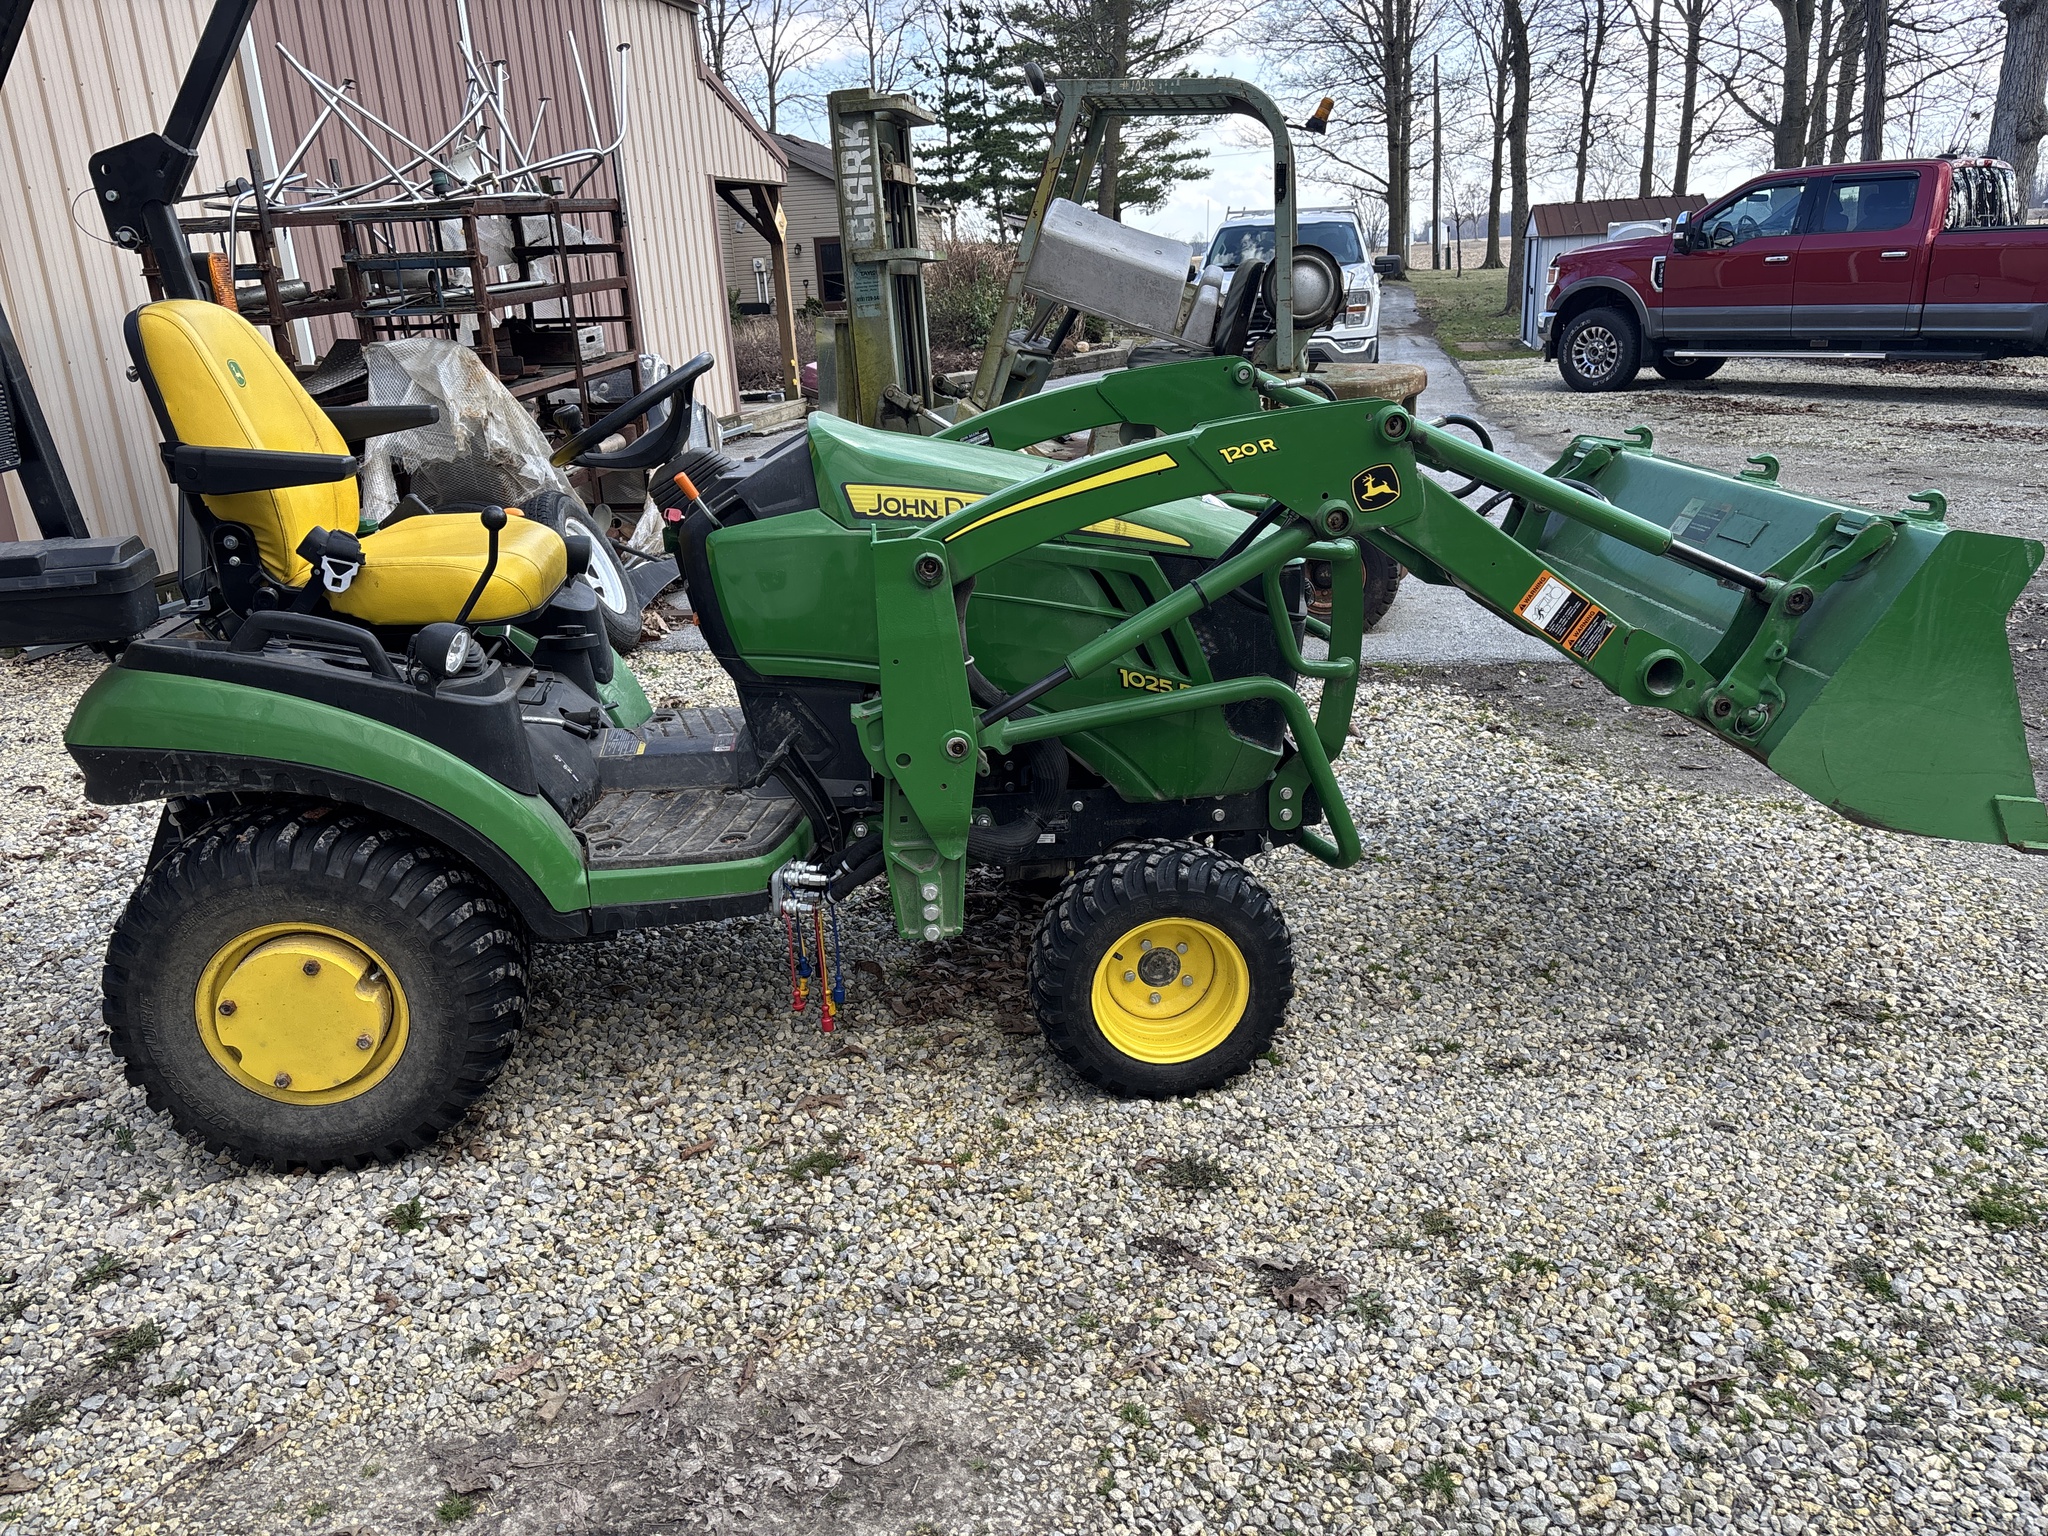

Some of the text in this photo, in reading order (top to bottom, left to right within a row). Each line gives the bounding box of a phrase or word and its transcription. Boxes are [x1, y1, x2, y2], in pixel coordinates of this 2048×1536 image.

[838, 121, 877, 241] CLARK
[1218, 438, 1279, 464] 120 R
[868, 493, 938, 517] JOHN
[1524, 576, 1546, 604] WARNING
[1573, 610, 1595, 638] WARNING
[1119, 668, 1174, 693] 1025
[139, 993, 164, 1061] TURF
